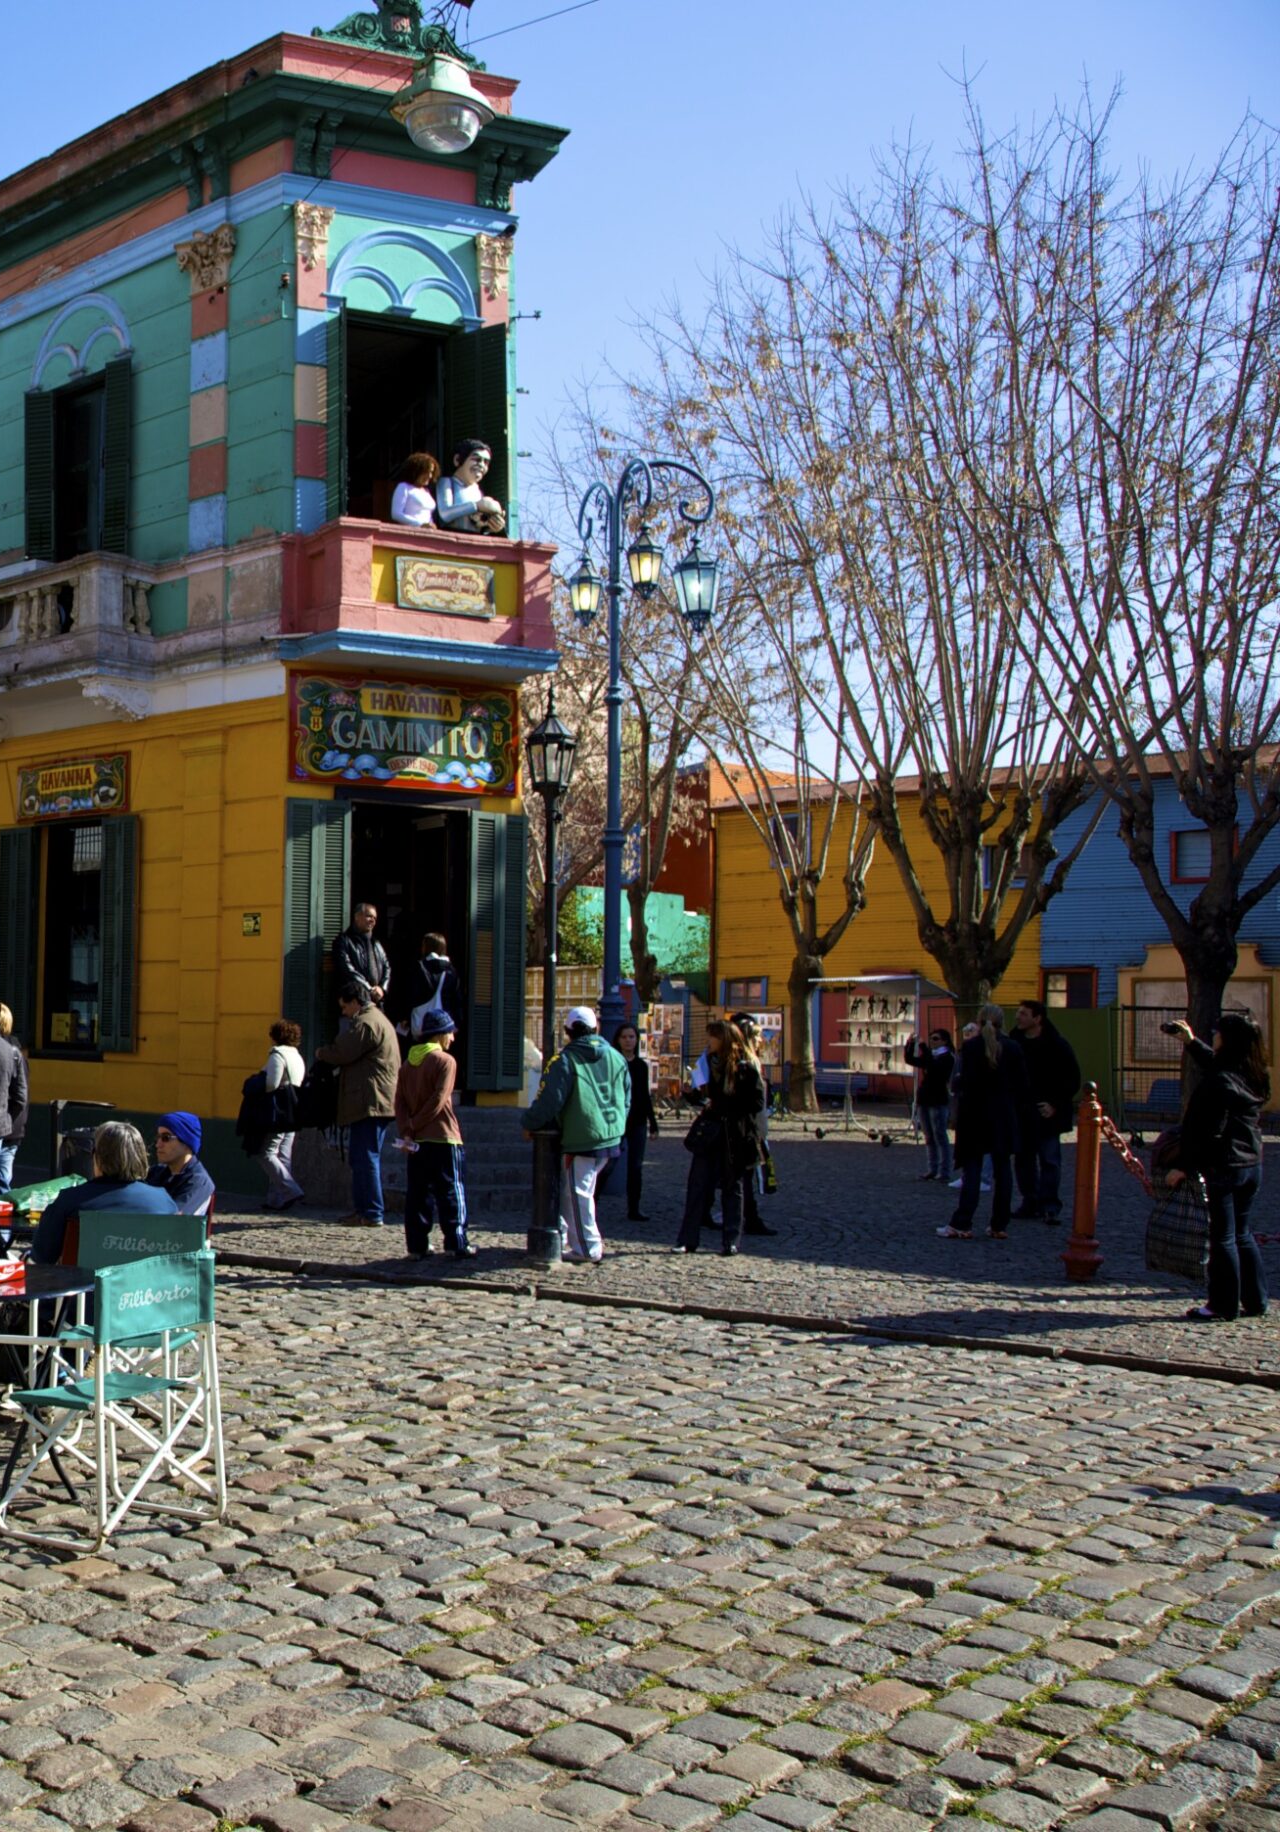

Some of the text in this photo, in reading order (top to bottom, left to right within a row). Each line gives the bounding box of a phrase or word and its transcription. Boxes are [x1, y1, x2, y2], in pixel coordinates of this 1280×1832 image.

[370, 690, 453, 717] HAVANNA
[312, 717, 320, 730] H
[331, 710, 488, 760] CAMINITO
[390, 758, 416, 772] DESDE
[40, 767, 94, 792] HAVANNA
[102, 1235, 184, 1253] Filiberto
[118, 1283, 194, 1311] Filiberto
